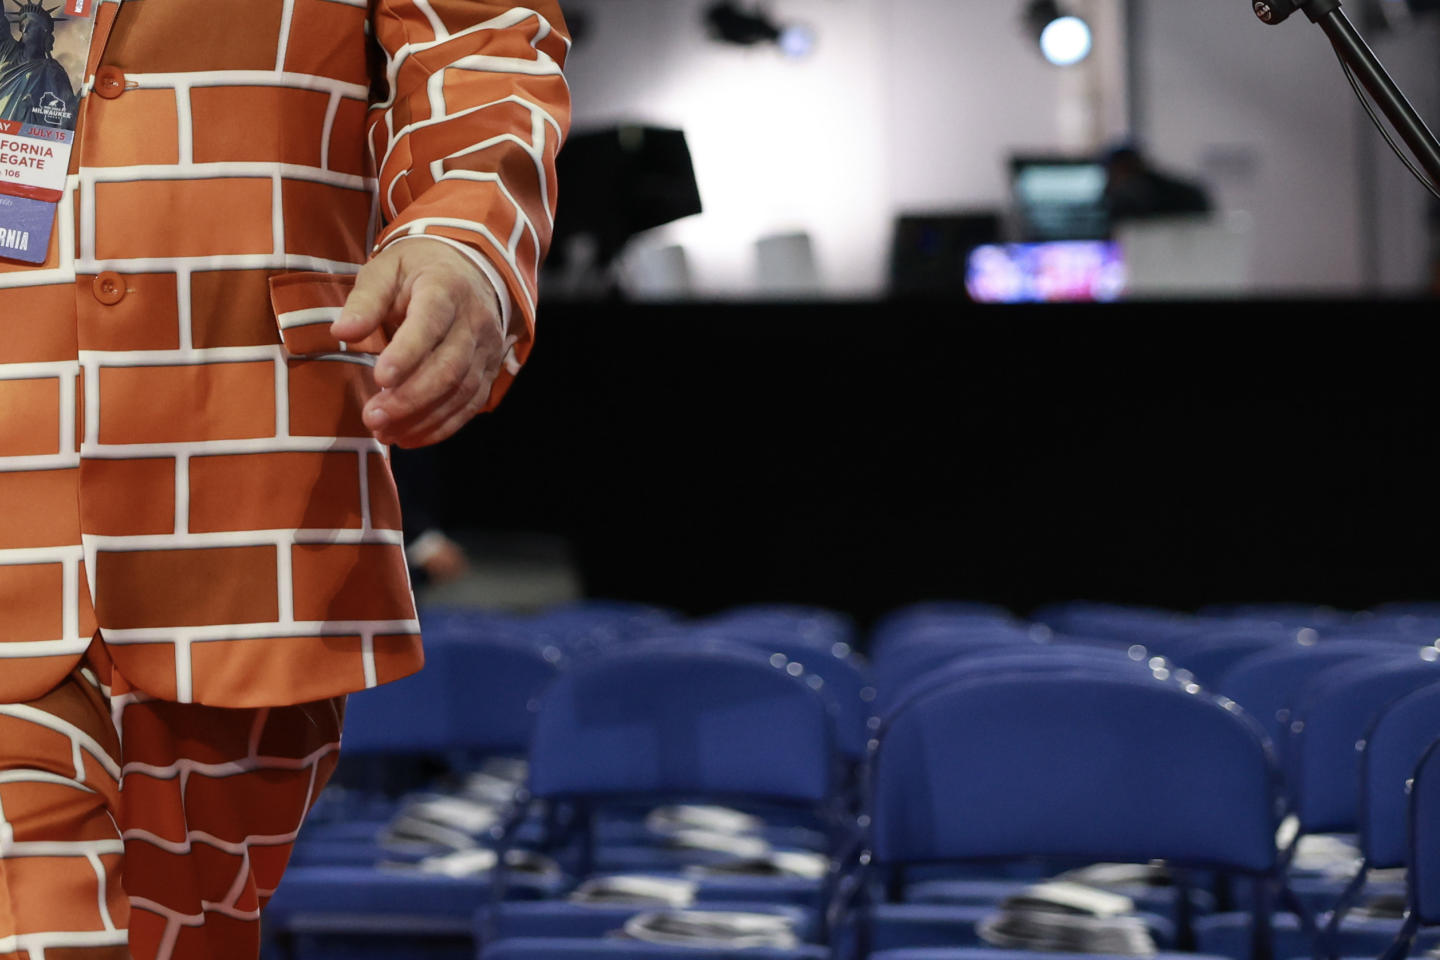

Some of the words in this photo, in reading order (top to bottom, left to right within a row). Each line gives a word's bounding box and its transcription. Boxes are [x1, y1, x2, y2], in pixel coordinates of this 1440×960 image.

[27, 127, 53, 139] JULY
[55, 131, 66, 141] 15
[4, 168, 21, 178] 106
